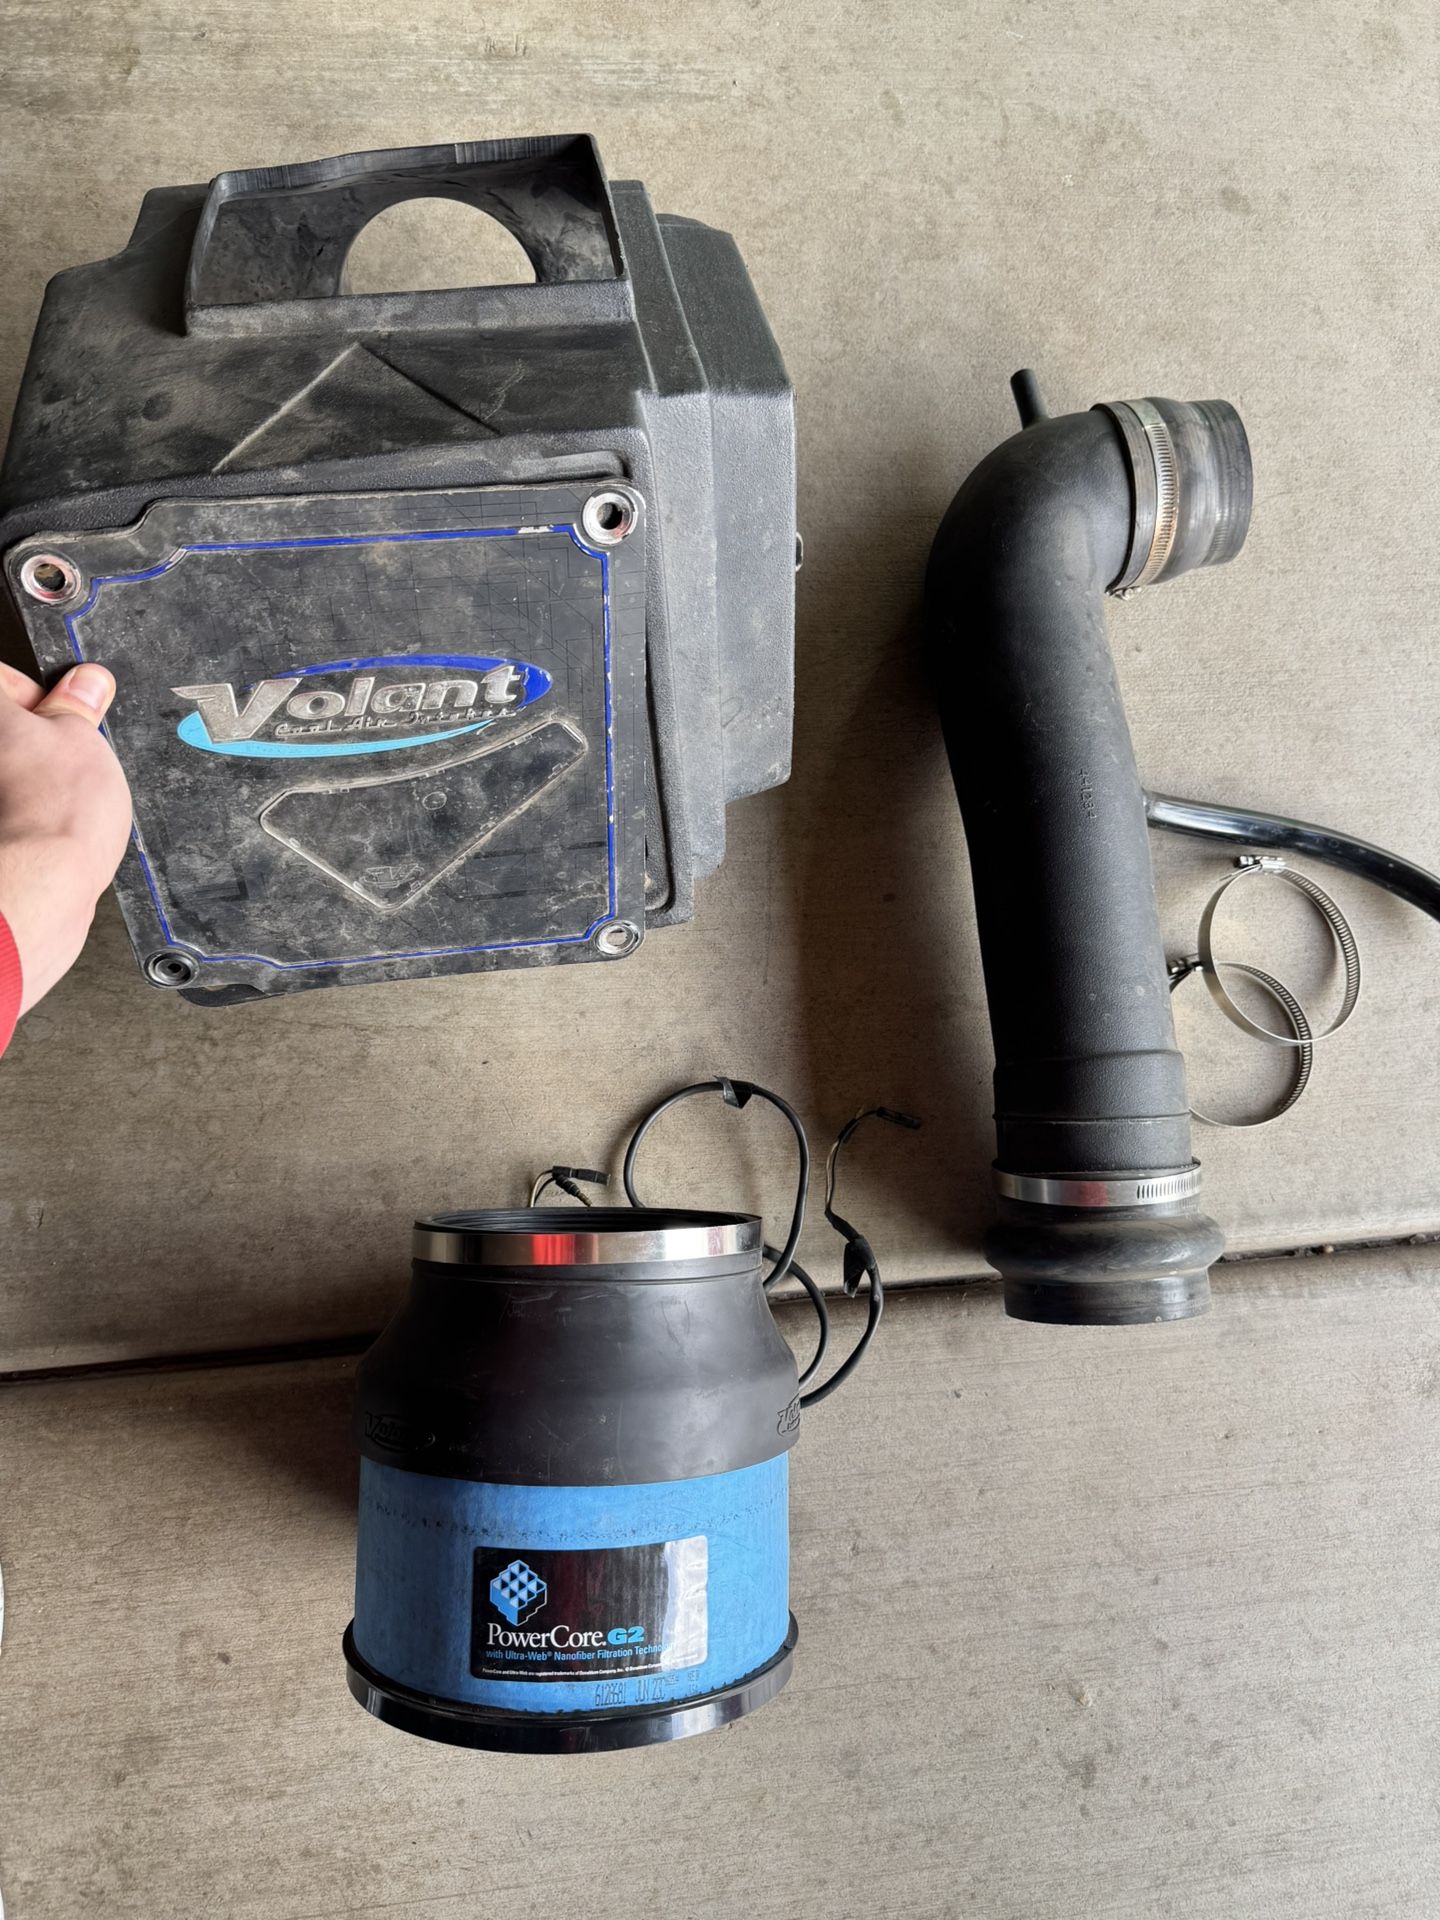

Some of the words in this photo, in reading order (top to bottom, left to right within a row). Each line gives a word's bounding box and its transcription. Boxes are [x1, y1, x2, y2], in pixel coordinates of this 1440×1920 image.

[170, 665, 521, 744] Volant
[607, 1626, 645, 1645] G2
[486, 1650, 504, 1659] with
[554, 1651, 595, 1661] Nanofiber
[597, 1649, 633, 1660] Filtration
